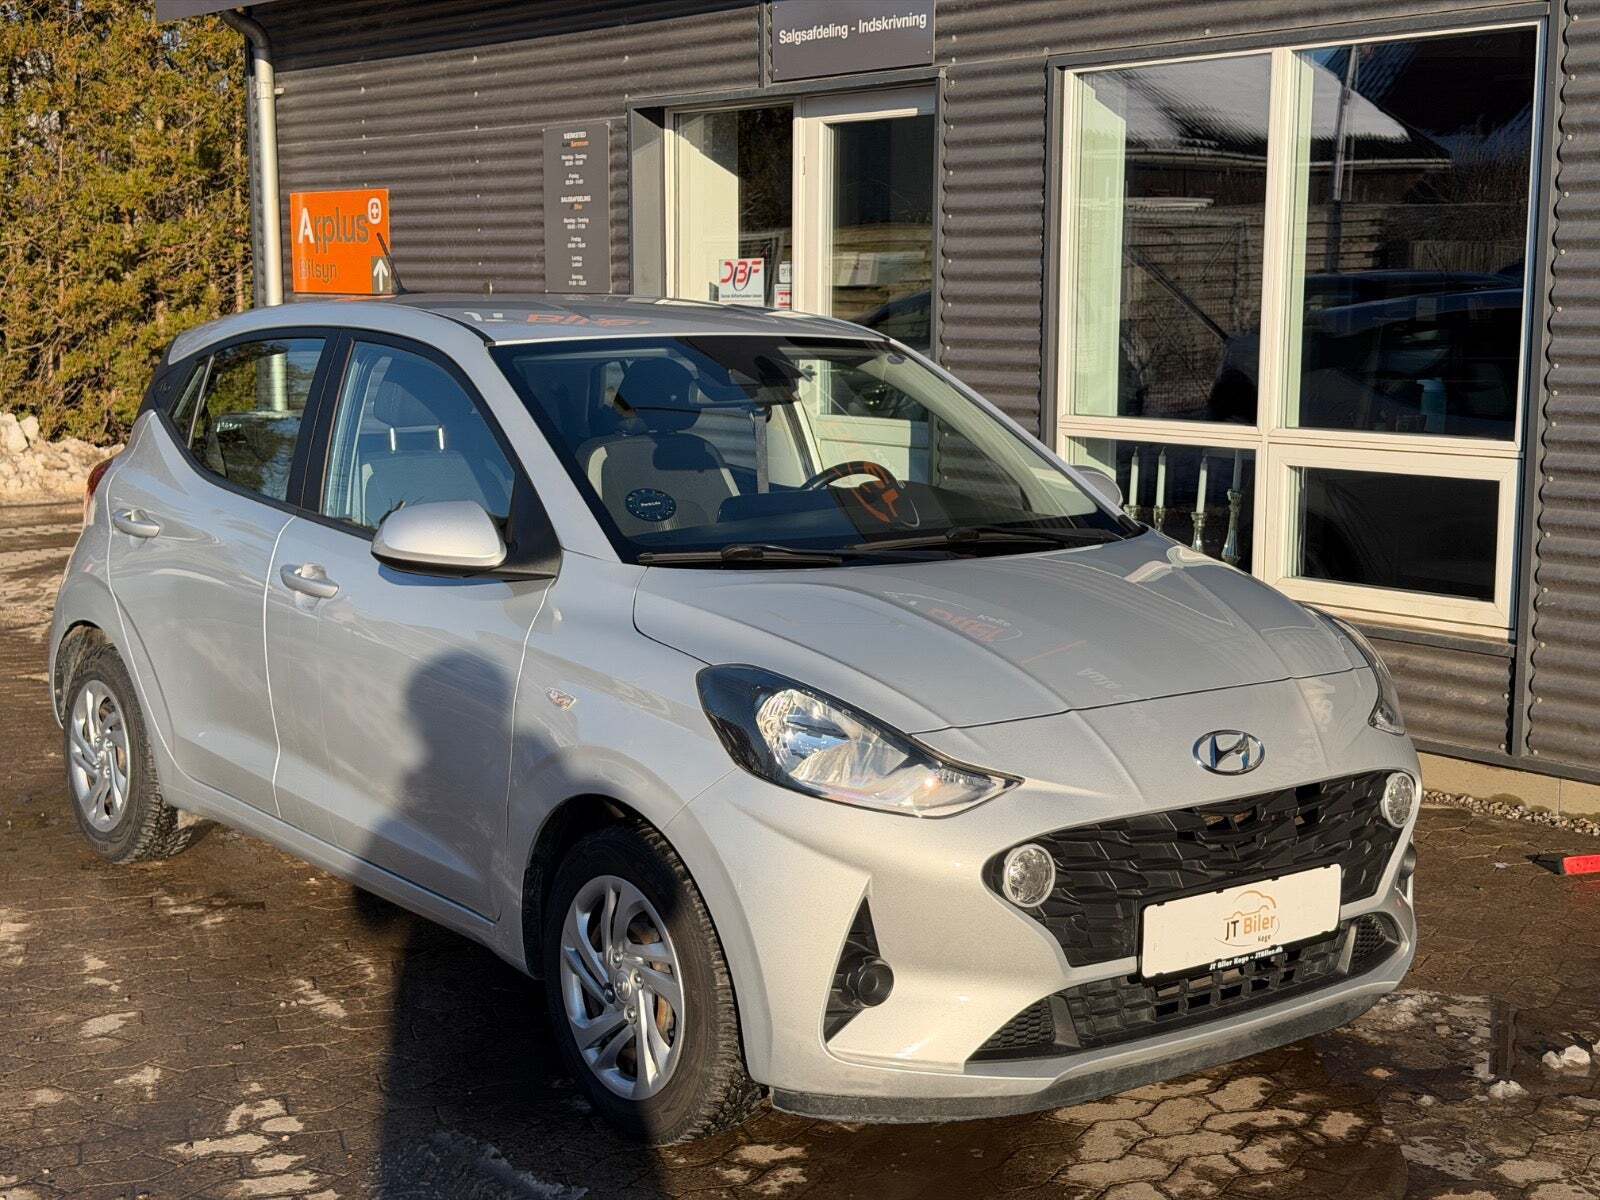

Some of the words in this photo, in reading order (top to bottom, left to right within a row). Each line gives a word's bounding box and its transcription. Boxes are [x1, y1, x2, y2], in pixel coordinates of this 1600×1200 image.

[779, 23, 849, 45] Salgsafdeling
[858, 13, 927, 34] Indskrivning
[300, 258, 337, 284] Bilsyn
[1224, 920, 1240, 941] JT
[1243, 913, 1276, 935] Biler
